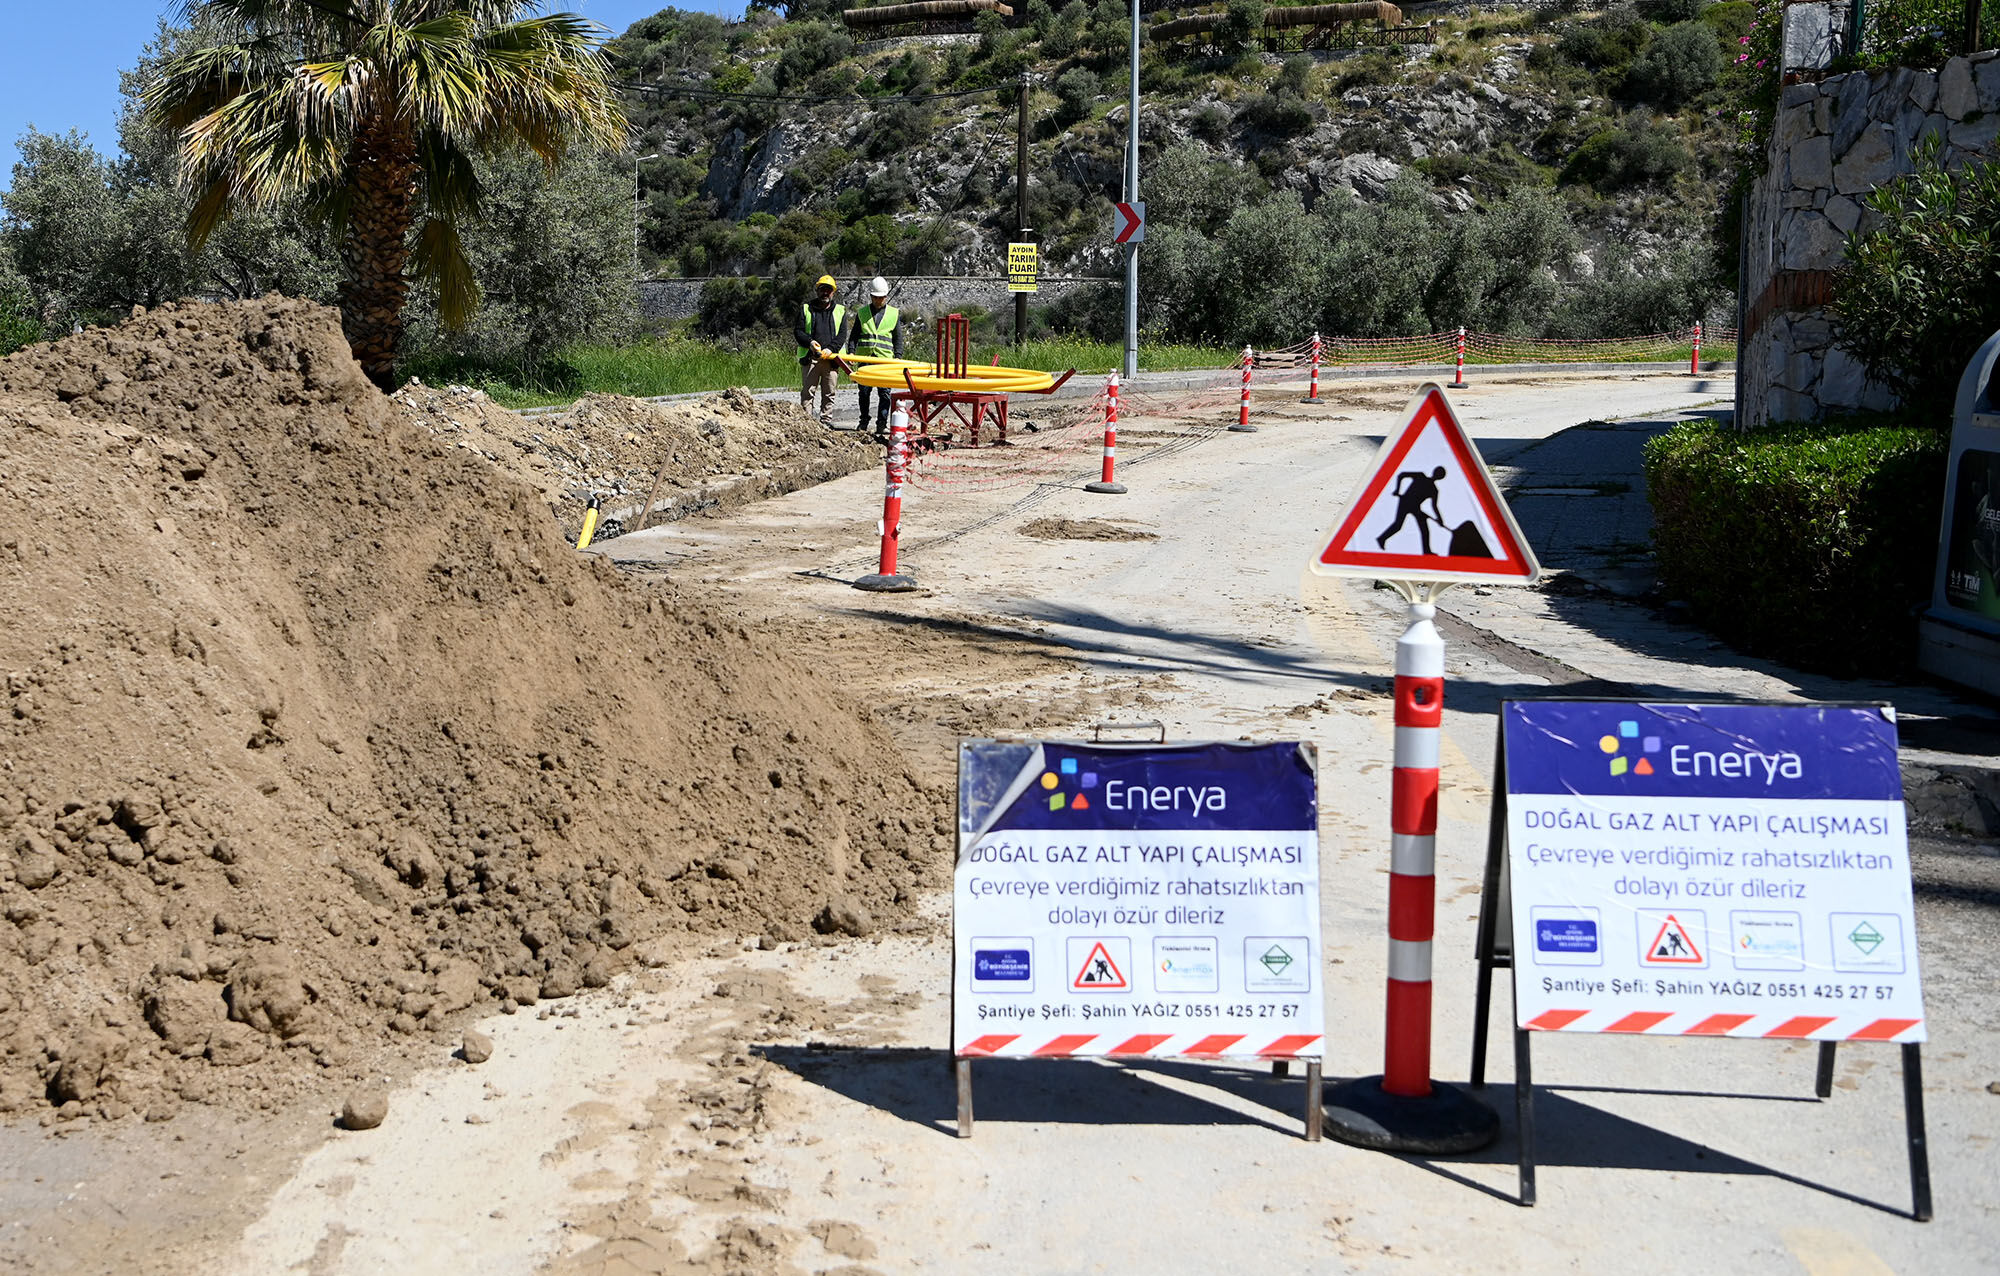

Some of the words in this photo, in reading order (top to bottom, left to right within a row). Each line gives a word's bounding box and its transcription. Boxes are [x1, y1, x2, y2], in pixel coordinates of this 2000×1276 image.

[1009, 264, 1035, 272] FUARI
[1010, 255, 1035, 263] TARIM
[1670, 744, 1802, 785] Enerya
[1106, 781, 1226, 817] Enerya
[1526, 808, 1601, 829] DOĞAL
[1609, 813, 1654, 830] GAZ
[1663, 814, 1700, 831] ALT
[1708, 815, 1758, 832] YAPI
[1767, 816, 1888, 838] ÇALIŞMASI
[970, 842, 1039, 863] DOĞAL
[1046, 846, 1088, 863] GAZ
[1095, 845, 1131, 863] ALT
[1138, 845, 1184, 863] YAPI
[1192, 846, 1302, 868] ÇALIŞMASI
[1527, 844, 1614, 867] Çevreye
[1621, 847, 1733, 870] verdiğimiz
[1742, 849, 1892, 869] rahatsızlıktan
[970, 878, 1049, 899] Çevreye
[1056, 877, 1160, 900] verdiğimiz
[1167, 877, 1303, 896] rahatsızlıktan
[1615, 876, 1678, 899] dolayı
[1686, 879, 1733, 896] özür
[1742, 879, 1805, 898] dileriz
[1049, 906, 1106, 927] dolayı
[1114, 906, 1158, 924] özür
[1165, 905, 1224, 924] dileriz
[1543, 977, 1605, 995] Şantiye
[1612, 979, 1648, 995] Şefi:
[1656, 980, 1703, 996] Şahin
[1709, 980, 1762, 996] YAĞIZ
[1768, 983, 1806, 997] 0551
[1814, 985, 1843, 999] 425
[1850, 985, 1868, 999] 27
[1876, 986, 1893, 1000] 57
[978, 1004, 1035, 1021] Şantiye
[1042, 1004, 1075, 1020] Şefi:
[1082, 1004, 1126, 1020] Şahin
[1132, 1002, 1179, 1017] YAĞIZ
[1185, 1004, 1219, 1017] 0551
[1227, 1005, 1253, 1017] 425
[1259, 1005, 1275, 1017] 27
[1282, 1004, 1299, 1017] 57
